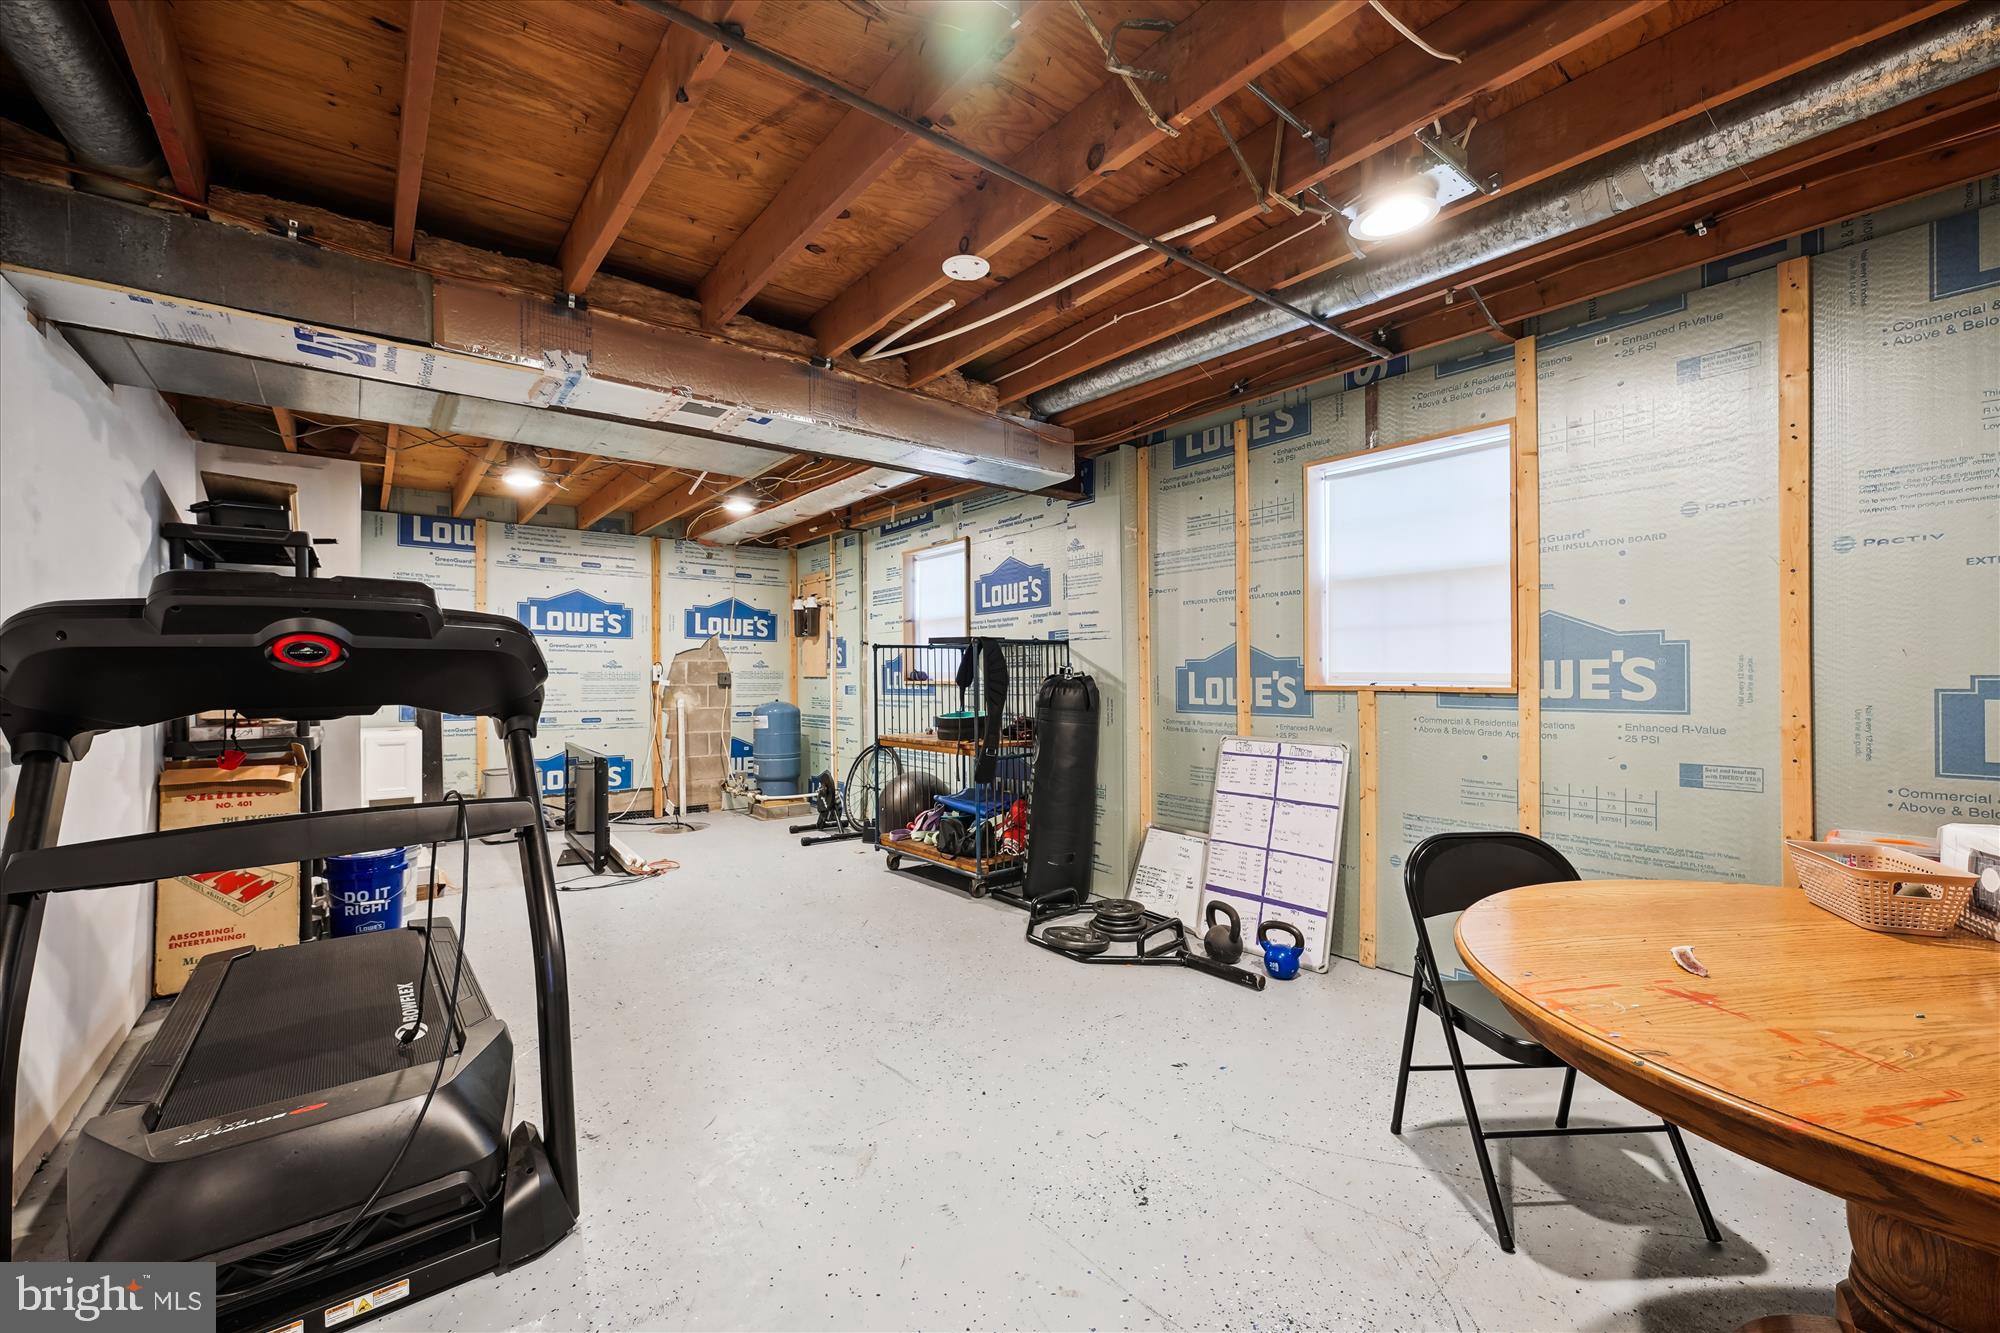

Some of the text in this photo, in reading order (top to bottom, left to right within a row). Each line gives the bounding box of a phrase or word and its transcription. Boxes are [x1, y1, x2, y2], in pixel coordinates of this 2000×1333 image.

[1893, 303, 1986, 332] Commercial
[1622, 311, 1724, 347] Enhanced R-Value
[1893, 316, 2000, 346] Above & Belo
[1622, 341, 1657, 358] 25 PSI
[1417, 382, 1462, 401] Commercial
[1463, 380, 1471, 388] &
[1538, 354, 1573, 370] ications
[1417, 384, 1501, 411] Above & Below Grade
[1186, 407, 1295, 458] LOES
[1277, 444, 1305, 456] Enhanced
[1705, 496, 1771, 511] PACTIV
[413, 515, 476, 546] LOW
[1540, 529, 1591, 544] nGuard™
[1563, 537, 1625, 551] INSULATION
[1628, 532, 1667, 544] BOARD
[1863, 532, 1945, 547] PACTIV
[982, 575, 1042, 608] LOWE'S
[1209, 596, 1236, 604] POLYSTYR
[530, 606, 623, 634] LOWE'S
[695, 612, 769, 638] LOWE'S
[1540, 650, 1657, 702] WE'S
[1279, 723, 1308, 732] Enhanced
[1418, 715, 1576, 731] Commercial & Residential ications
[1418, 725, 1442, 734] Above
[1443, 726, 1450, 735] &
[1451, 727, 1475, 736] Below
[1625, 722, 1727, 736] Enhanced R-Value
[1624, 735, 1660, 745] 25 PSI
[1898, 787, 1992, 804] Commercial
[1898, 801, 2000, 819] Above & Belo
[344, 886, 391, 904] DO IT
[344, 900, 391, 916] RIGHT
[169, 927, 235, 942] ABSORBING!
[359, 923, 383, 933] LOWE'S
[168, 933, 246, 950] ENTERTAINING!
[397, 981, 420, 1023] BOWFLEX
